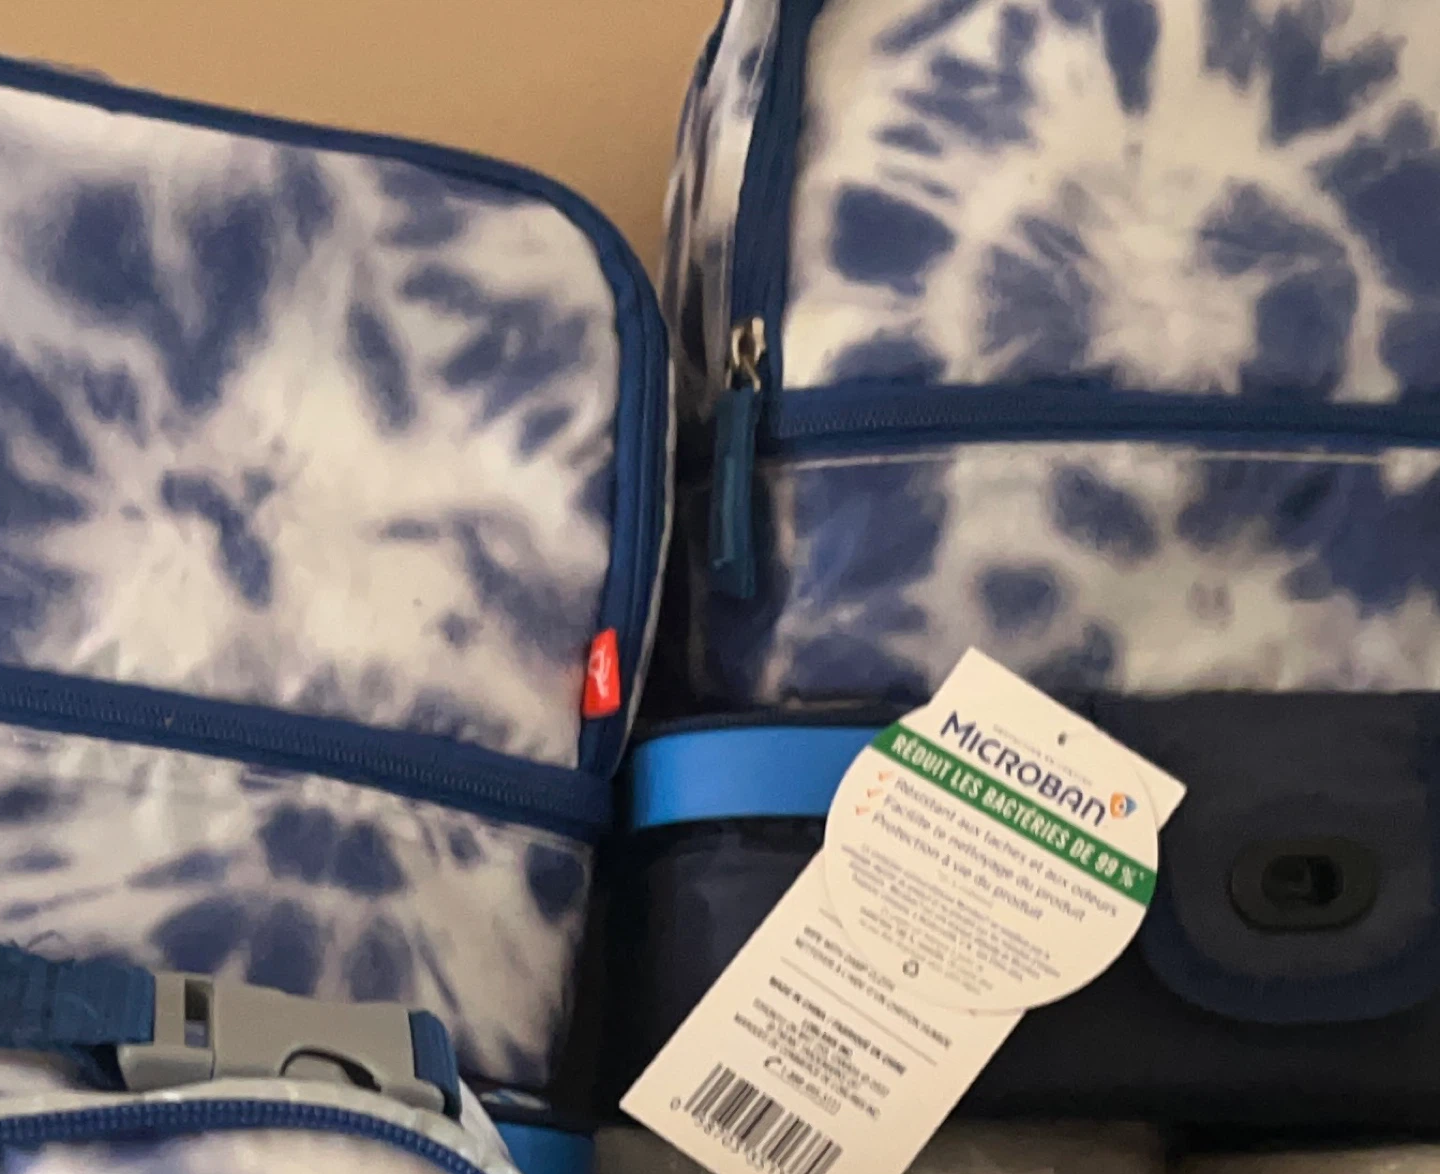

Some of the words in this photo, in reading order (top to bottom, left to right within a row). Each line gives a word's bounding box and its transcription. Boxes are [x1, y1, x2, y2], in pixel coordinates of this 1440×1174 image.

[891, 733, 952, 778] RÉDUIT
[950, 768, 983, 798] LES
[982, 786, 1070, 849] BACTÉRIES
[1069, 837, 1095, 865] DE
[1095, 852, 1119, 877] 99
[940, 709, 1107, 827] MICROBAN
[872, 812, 940, 860] Protection
[974, 875, 991, 891] du
[992, 886, 1043, 921] produit
[957, 818, 980, 837] aux
[1029, 859, 1044, 874] et
[1045, 868, 1068, 888] aux
[1016, 876, 1034, 892] du
[1035, 886, 1086, 922] produit
